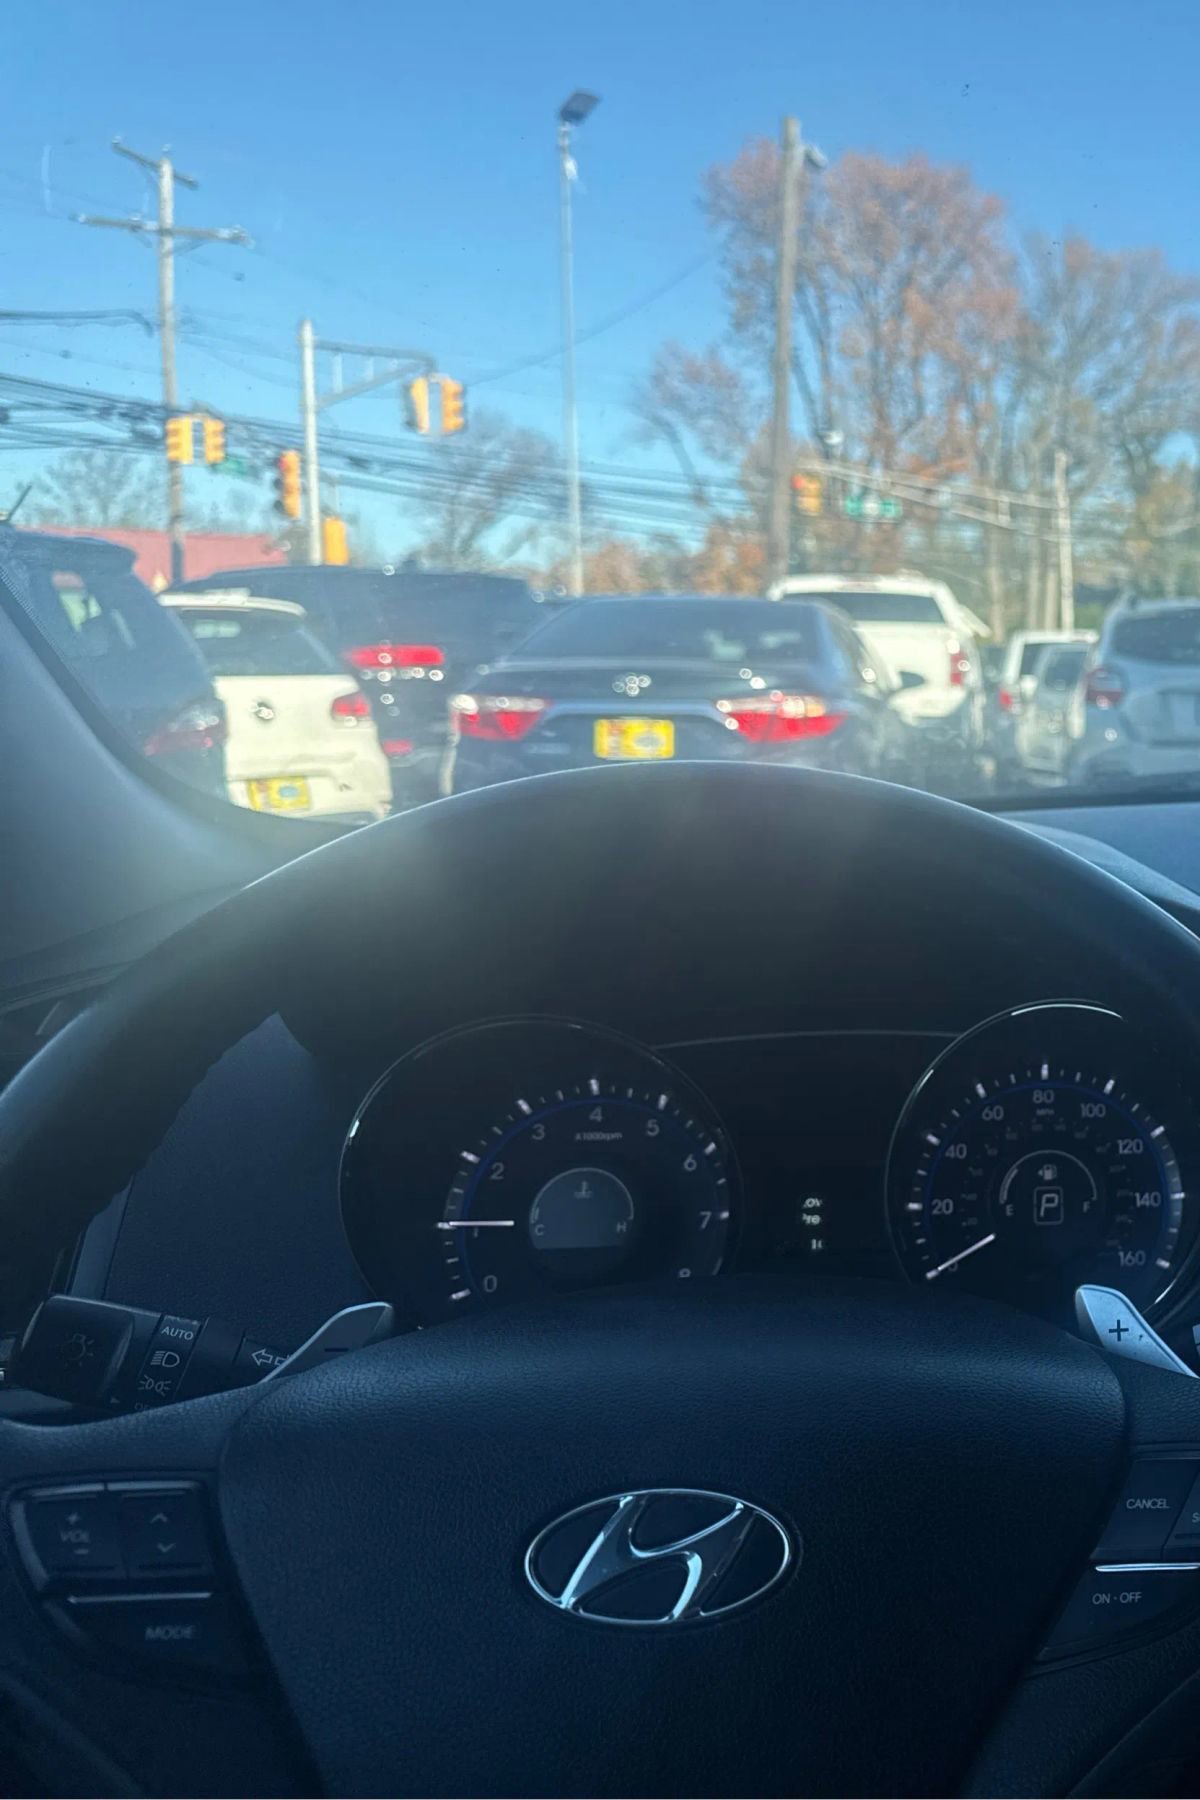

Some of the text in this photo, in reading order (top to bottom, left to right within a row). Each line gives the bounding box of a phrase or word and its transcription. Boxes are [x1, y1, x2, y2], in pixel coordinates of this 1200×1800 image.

[1032, 1089, 1054, 1104] 80
[589, 1106, 603, 1122] 4
[982, 1106, 1004, 1121] 60
[1080, 1103, 1106, 1118] 100
[532, 1123, 545, 1140] 3
[646, 1119, 659, 1137] 5
[945, 1143, 967, 1159] 40
[1117, 1138, 1144, 1154] 120
[490, 1161, 504, 1180] 2
[684, 1154, 697, 1171] 6
[932, 1199, 954, 1215] 20
[1040, 1192, 1059, 1217] P
[1083, 1201, 1091, 1213] F
[1135, 1192, 1162, 1208] 140
[1006, 1204, 1014, 1216] E
[616, 1221, 627, 1232] H
[700, 1211, 712, 1229] 7
[535, 1224, 545, 1236] C
[1118, 1251, 1146, 1267] 160
[483, 1275, 498, 1293] 0
[161, 1325, 194, 1341] AUTO
[1126, 1498, 1170, 1510] CANCEL
[146, 1626, 196, 1641] MODE
